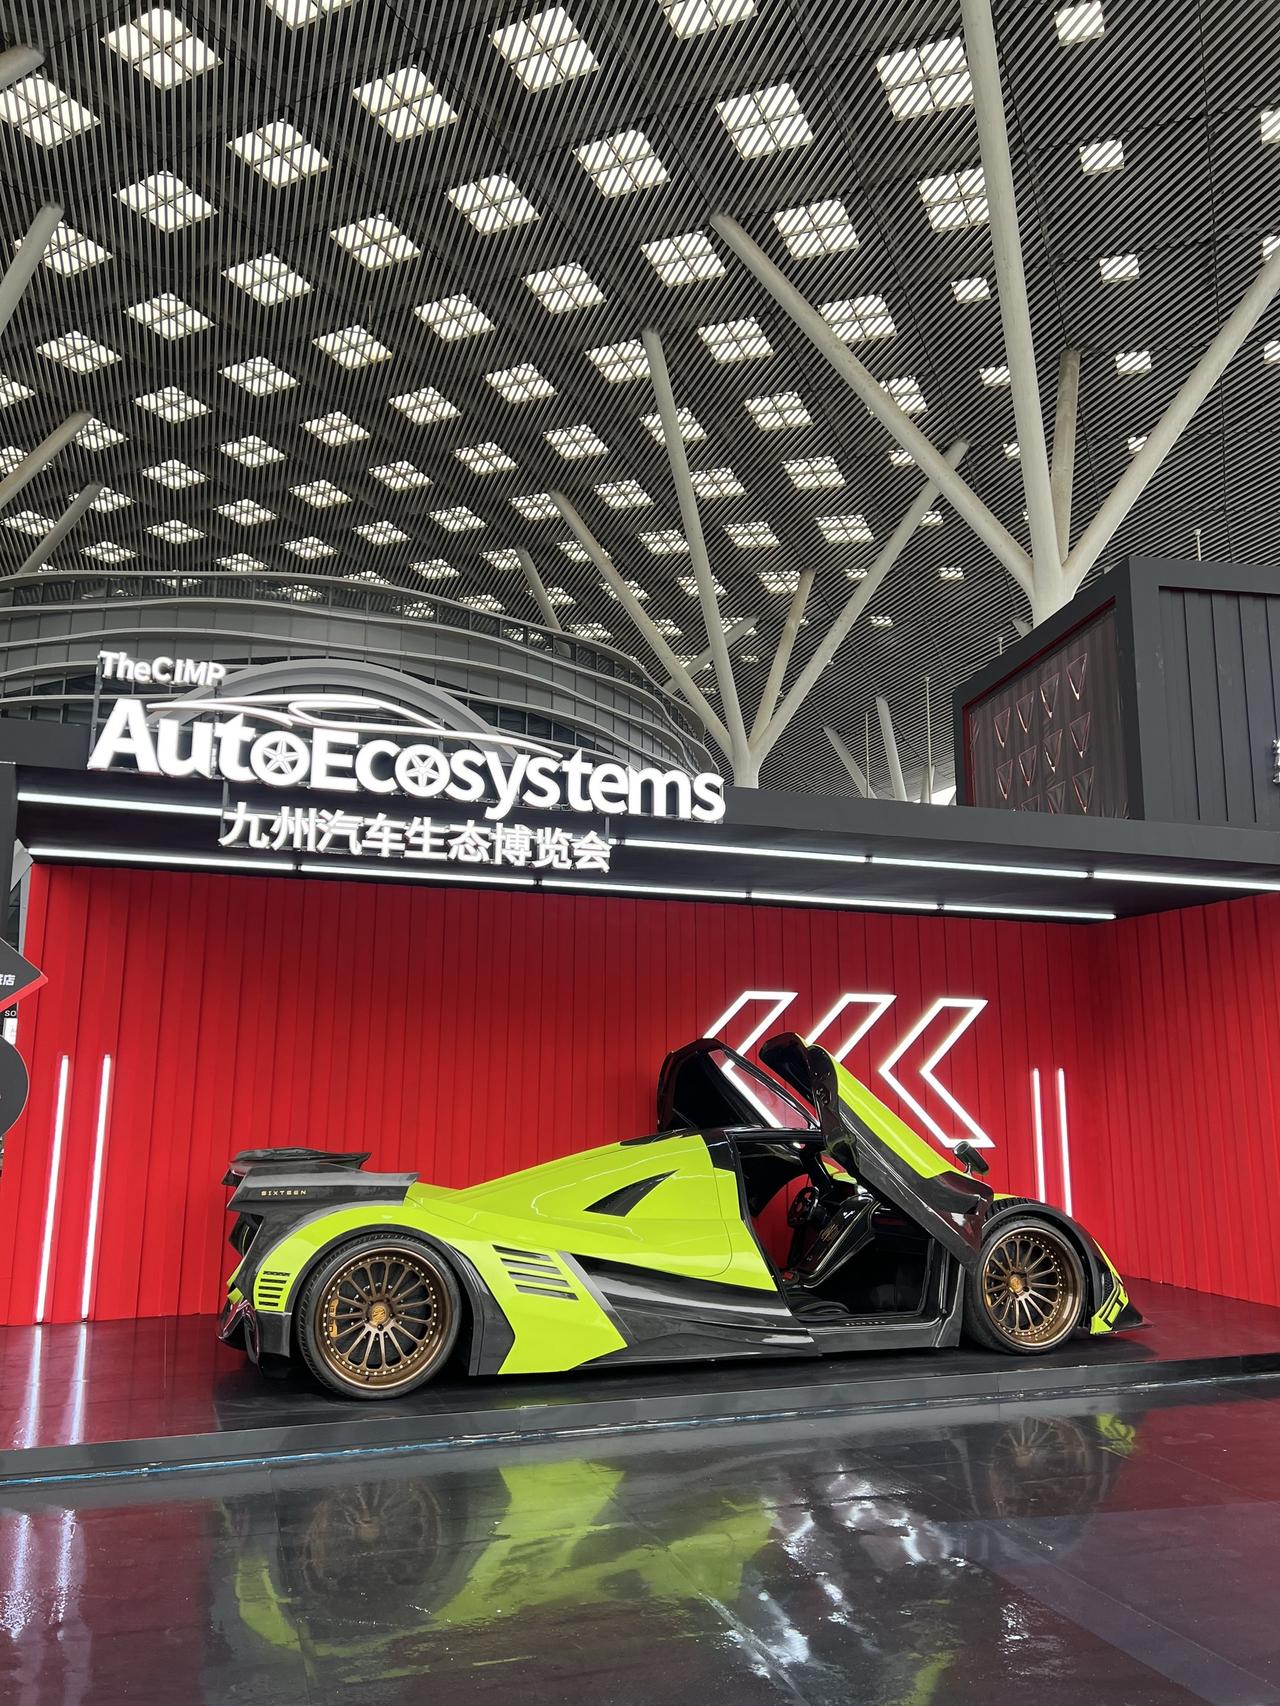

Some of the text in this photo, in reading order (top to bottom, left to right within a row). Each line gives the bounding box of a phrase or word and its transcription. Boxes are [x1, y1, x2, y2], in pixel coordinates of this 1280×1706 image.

[87, 697, 727, 823] AutoEcosystems
[218, 801, 613, 873] 九州汽车生态博览会
